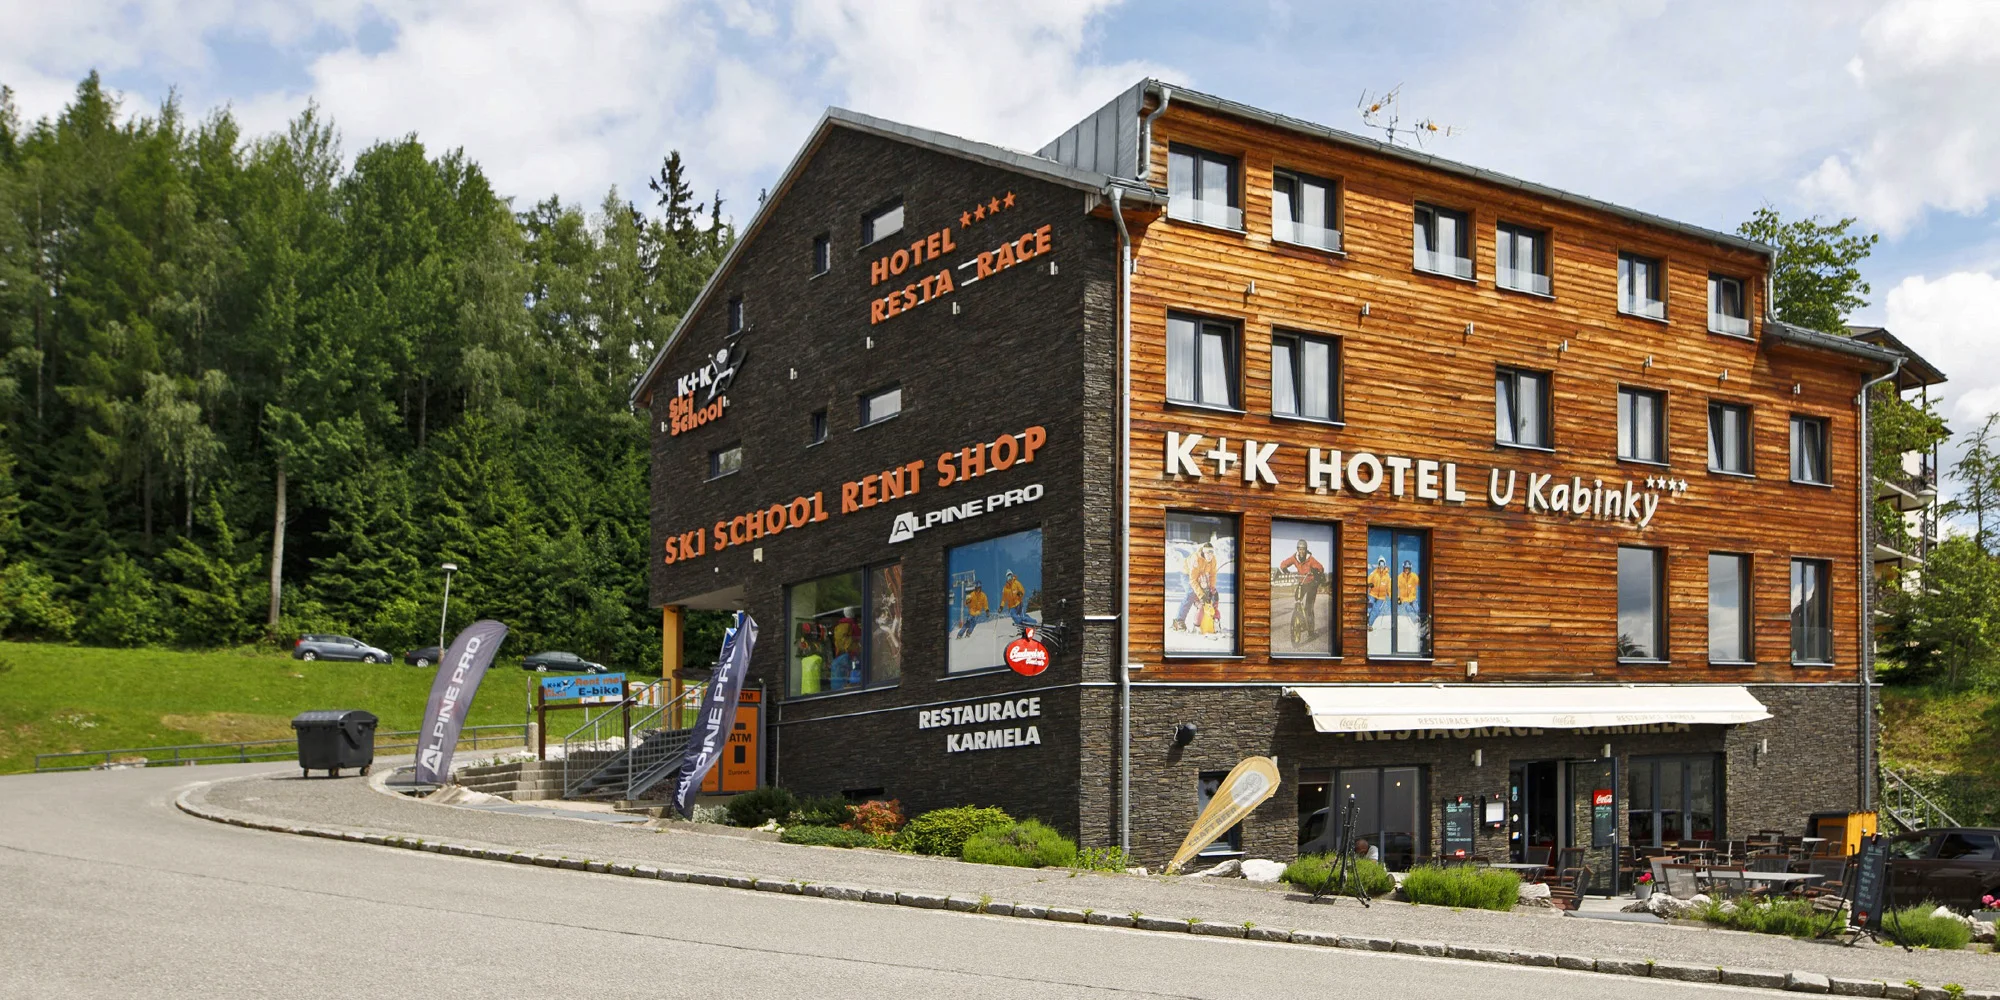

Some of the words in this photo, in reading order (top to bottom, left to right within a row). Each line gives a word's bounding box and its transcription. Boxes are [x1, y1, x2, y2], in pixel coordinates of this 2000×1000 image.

[871, 227, 957, 286] HOTEL
[871, 268, 955, 325] RESTA
[976, 223, 1052, 280] RACE
[677, 364, 713, 397] K+K
[669, 390, 695, 418] Ski
[671, 396, 723, 436] School
[664, 528, 706, 565] SKI
[713, 491, 829, 550] SCHOOL
[841, 459, 925, 514] RENT
[937, 425, 1047, 487] SHOP
[1165, 431, 1280, 485] K+K
[1307, 447, 1466, 502] HOTEL
[1490, 468, 1516, 506] U
[1527, 472, 1659, 529] Kabinky
[888, 499, 984, 544] ALPINE
[986, 483, 1044, 513] PRO
[575, 677, 600, 686] Rent
[602, 675, 622, 685] me!
[578, 686, 620, 696] E-bike
[420, 685, 460, 775] ALPINE
[452, 636, 481, 685] PRO
[919, 697, 1041, 729] RESTAURACE
[1418, 717, 1469, 725] RESTAURACE
[729, 733, 752, 743] ATM
[947, 726, 1041, 753] KARMELA
